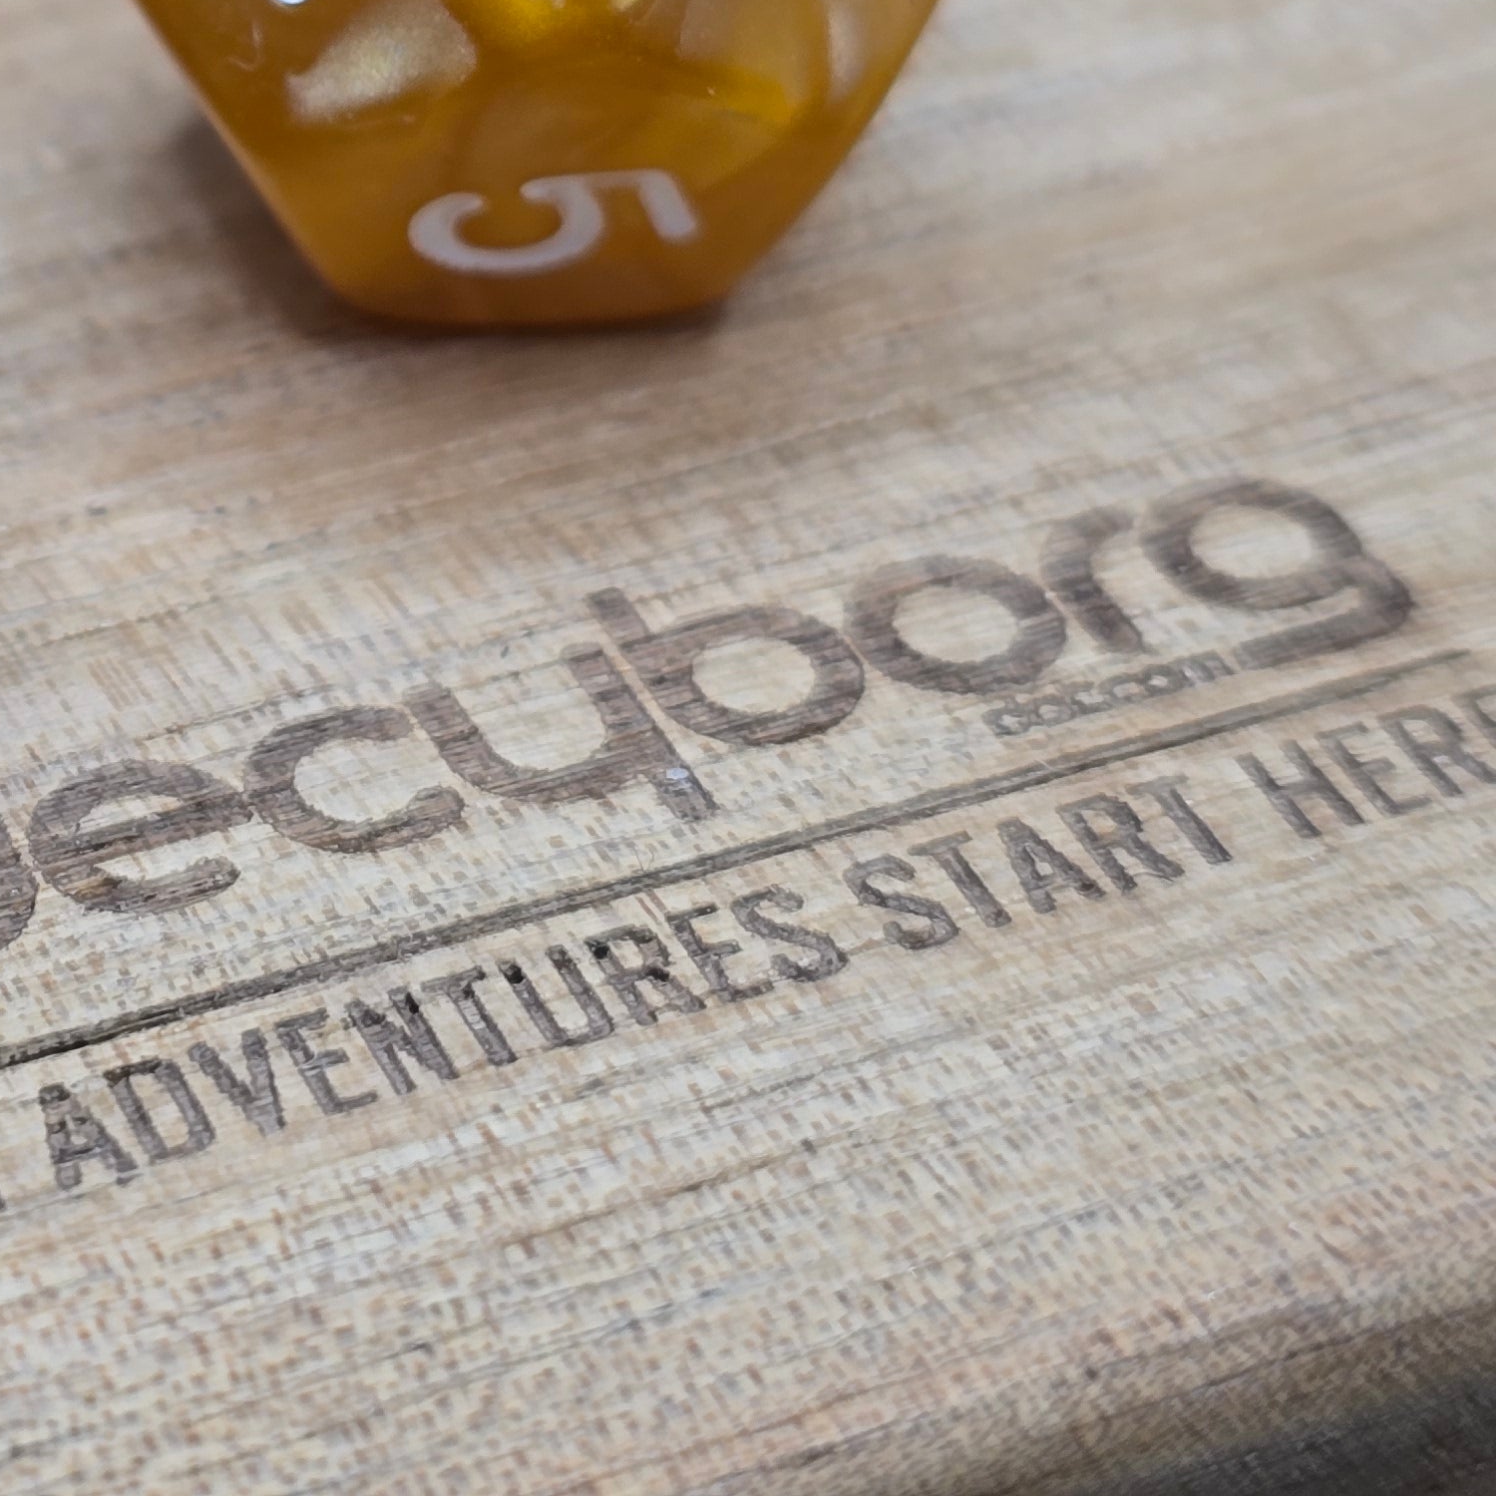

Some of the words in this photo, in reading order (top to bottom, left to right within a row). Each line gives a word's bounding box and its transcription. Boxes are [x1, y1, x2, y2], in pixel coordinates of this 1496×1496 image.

[407, 168, 698, 276] 5
[36, 886, 850, 1190] ADVENTURES
[842, 774, 1234, 952] START
